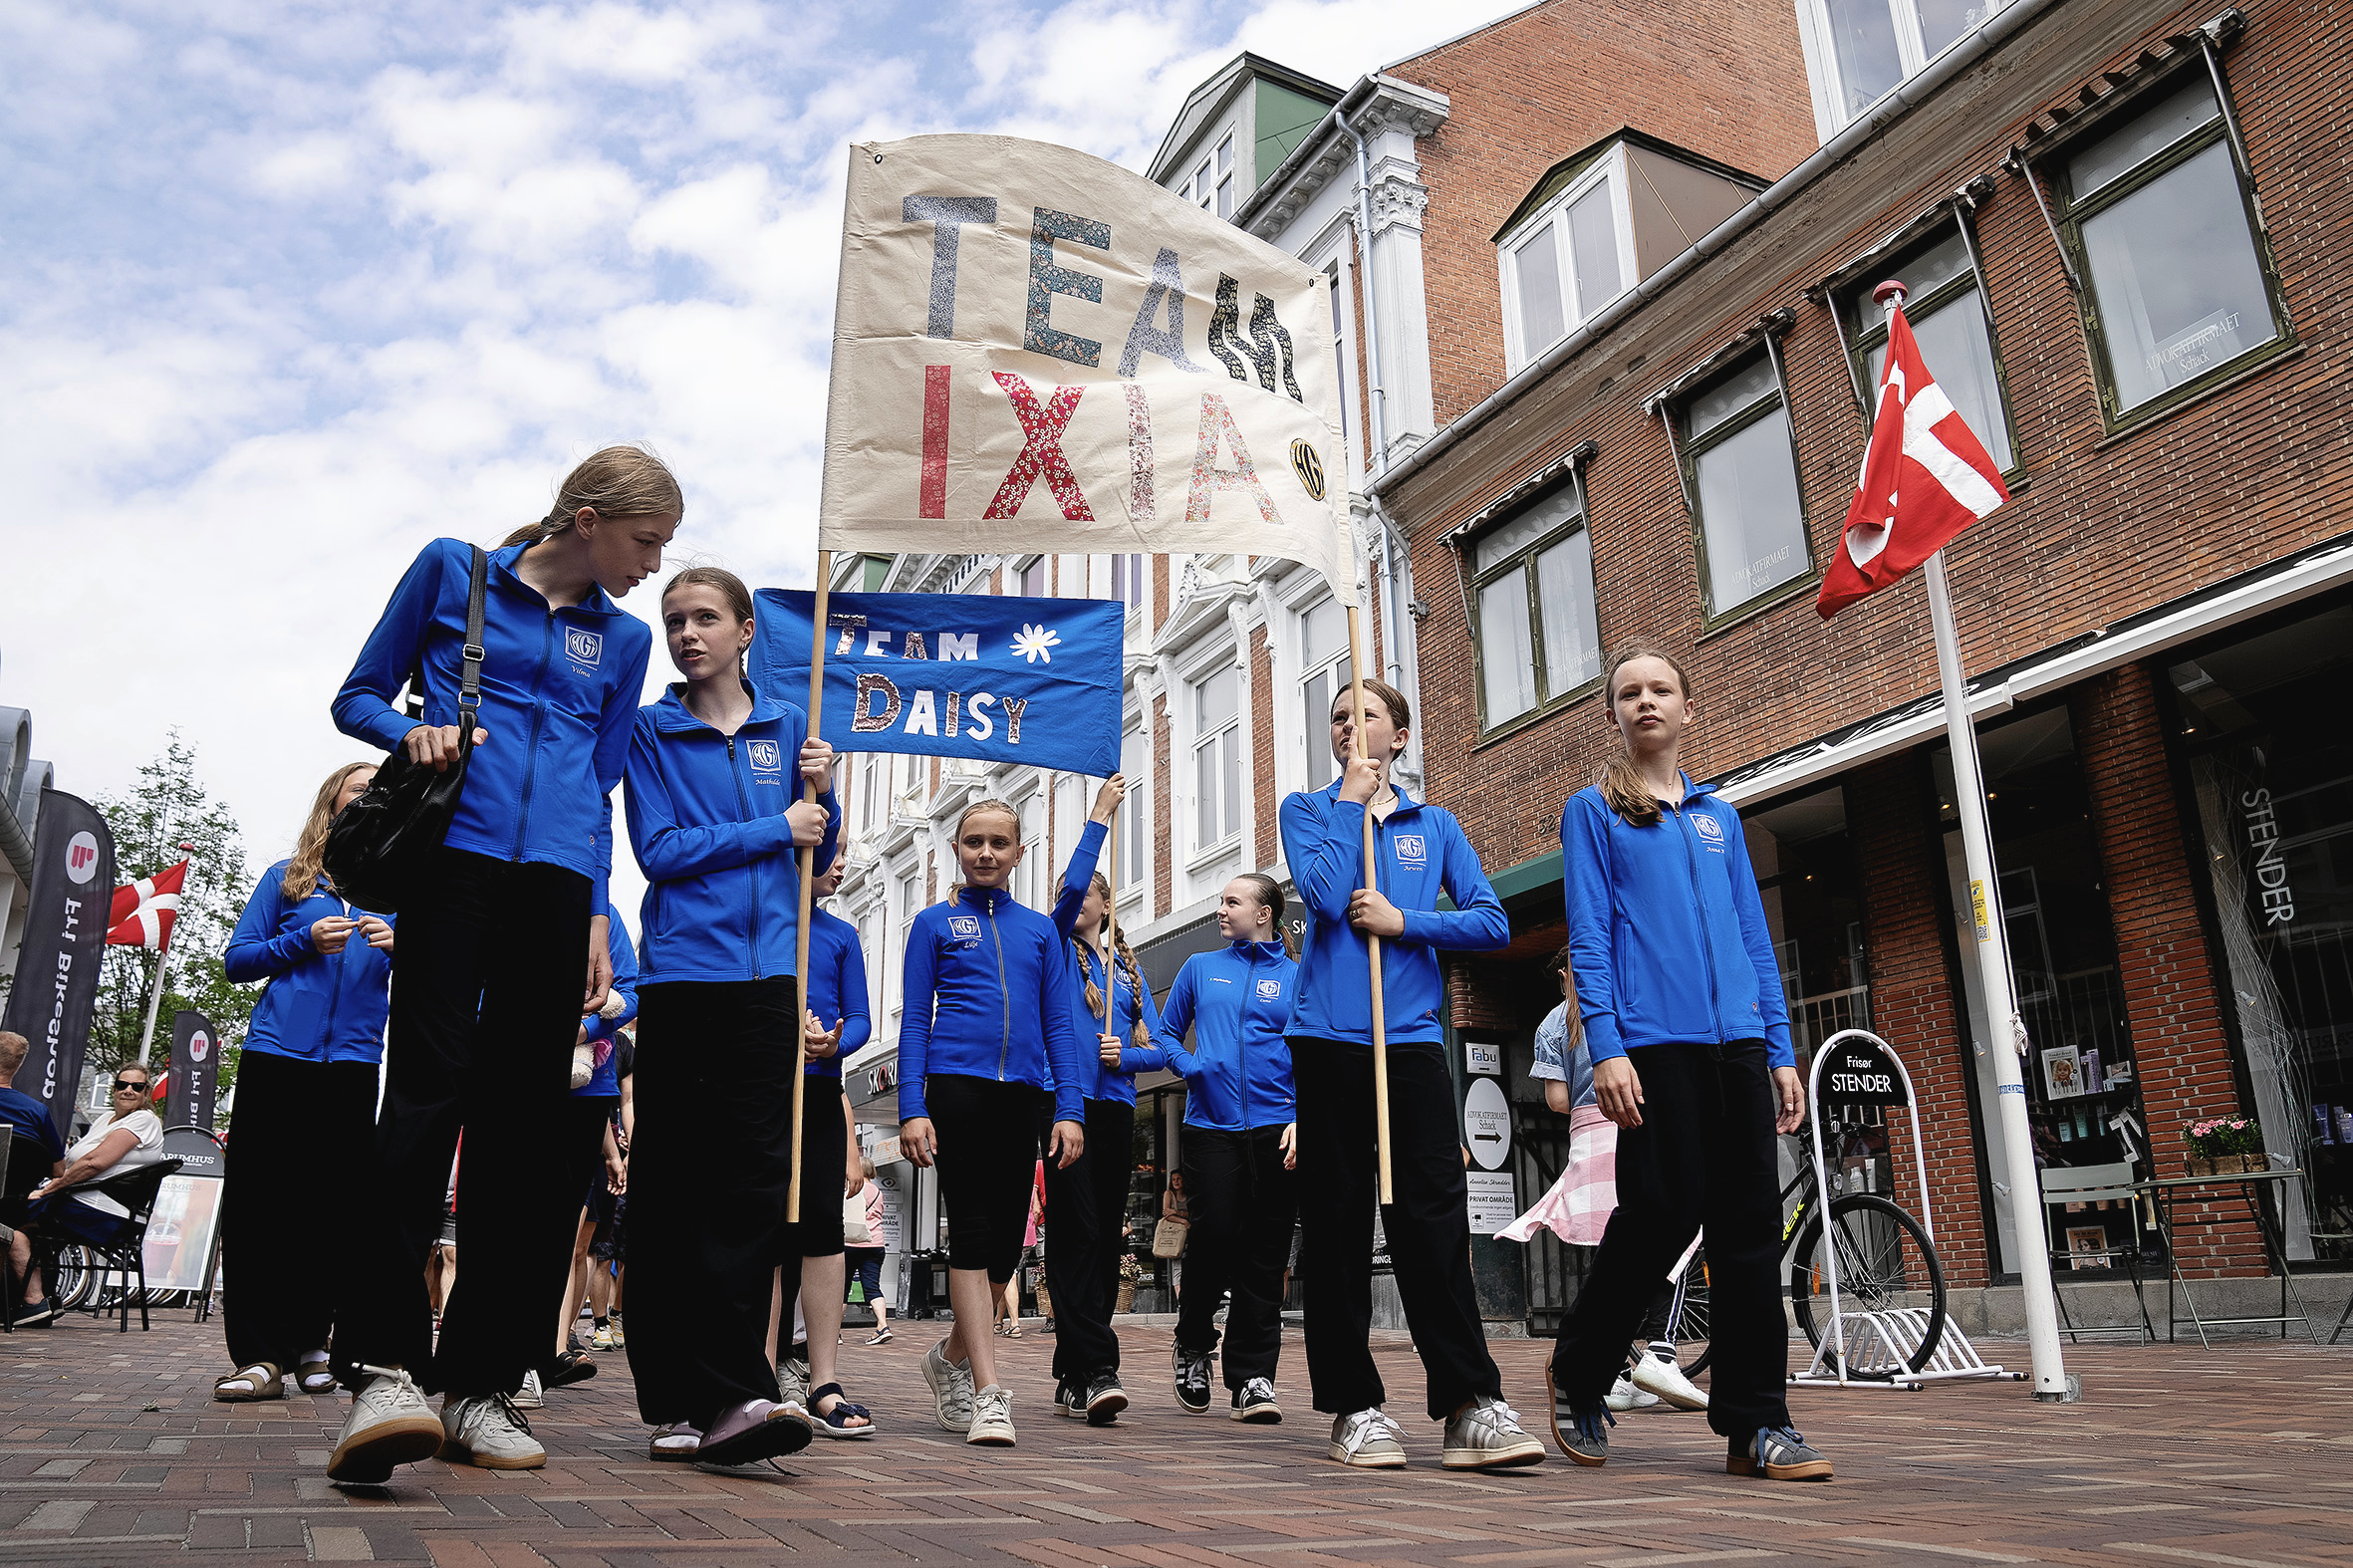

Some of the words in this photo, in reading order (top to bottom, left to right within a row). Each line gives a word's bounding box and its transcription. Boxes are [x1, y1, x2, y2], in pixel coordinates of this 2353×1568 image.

[903, 195, 1303, 403] TEAM
[2179, 349, 2211, 374] Schack
[918, 365, 1285, 525] IXIA
[829, 613, 980, 662] TEAM
[571, 664, 591, 677] Vilma
[850, 671, 1028, 744] DAISY
[2241, 787, 2295, 926] STENDER
[1471, 1047, 1497, 1063] Fabu
[1847, 1055, 1873, 1069] Frisør
[1831, 1073, 1893, 1093] STENDER
[1488, 1194, 1513, 1203] OMRÅDE
